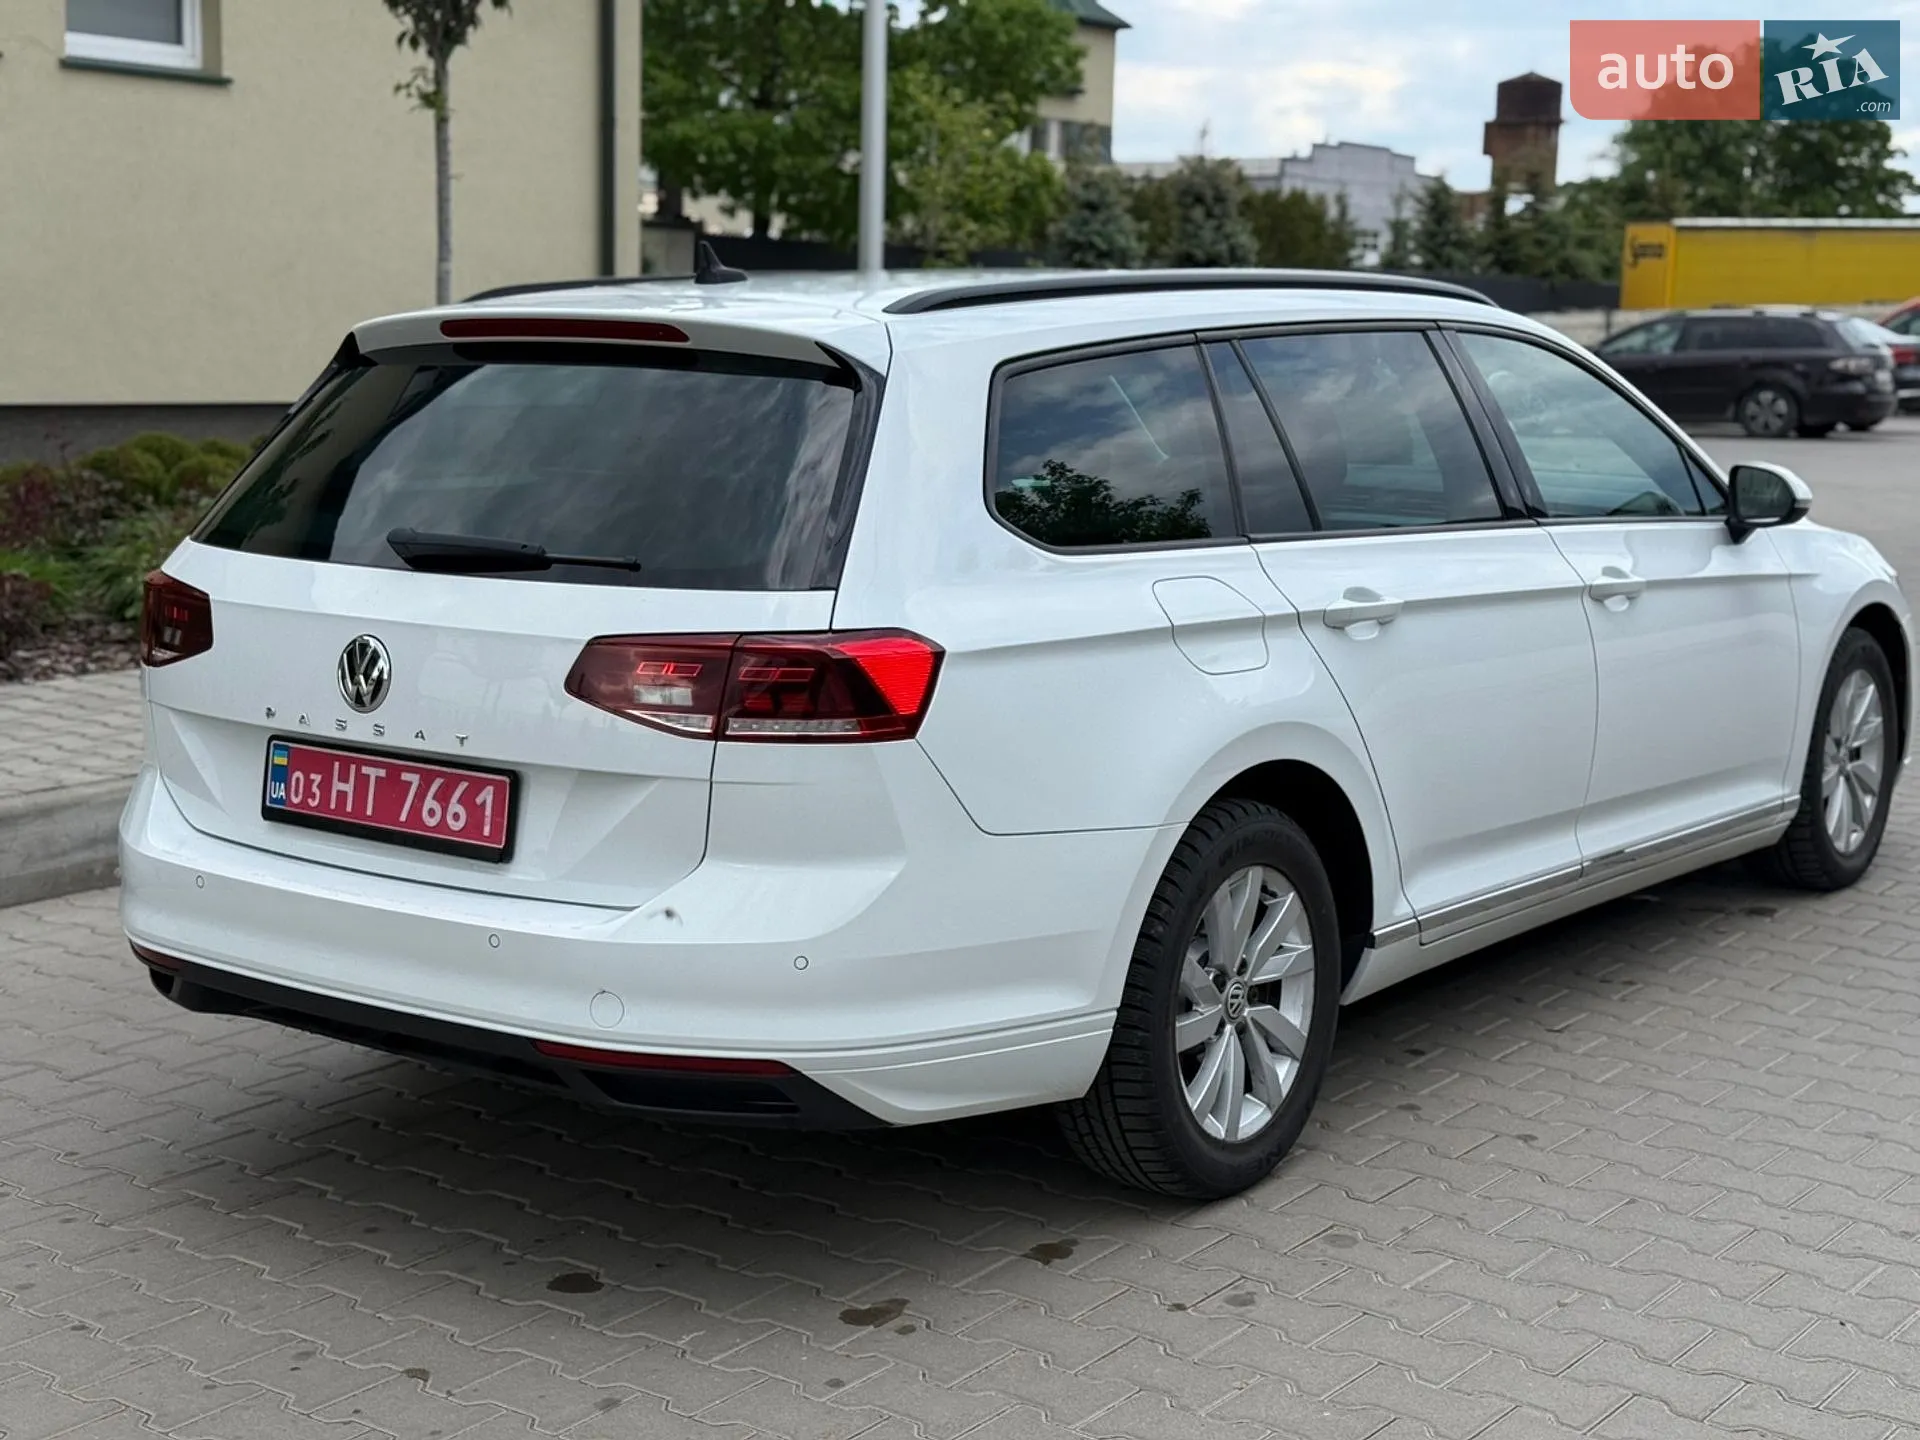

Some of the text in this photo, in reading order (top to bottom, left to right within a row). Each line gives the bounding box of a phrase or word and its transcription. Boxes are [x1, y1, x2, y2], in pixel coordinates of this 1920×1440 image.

[265, 705, 469, 747] PASSAT
[270, 780, 287, 800] UA
[289, 760, 495, 837] 03 HT 7661
